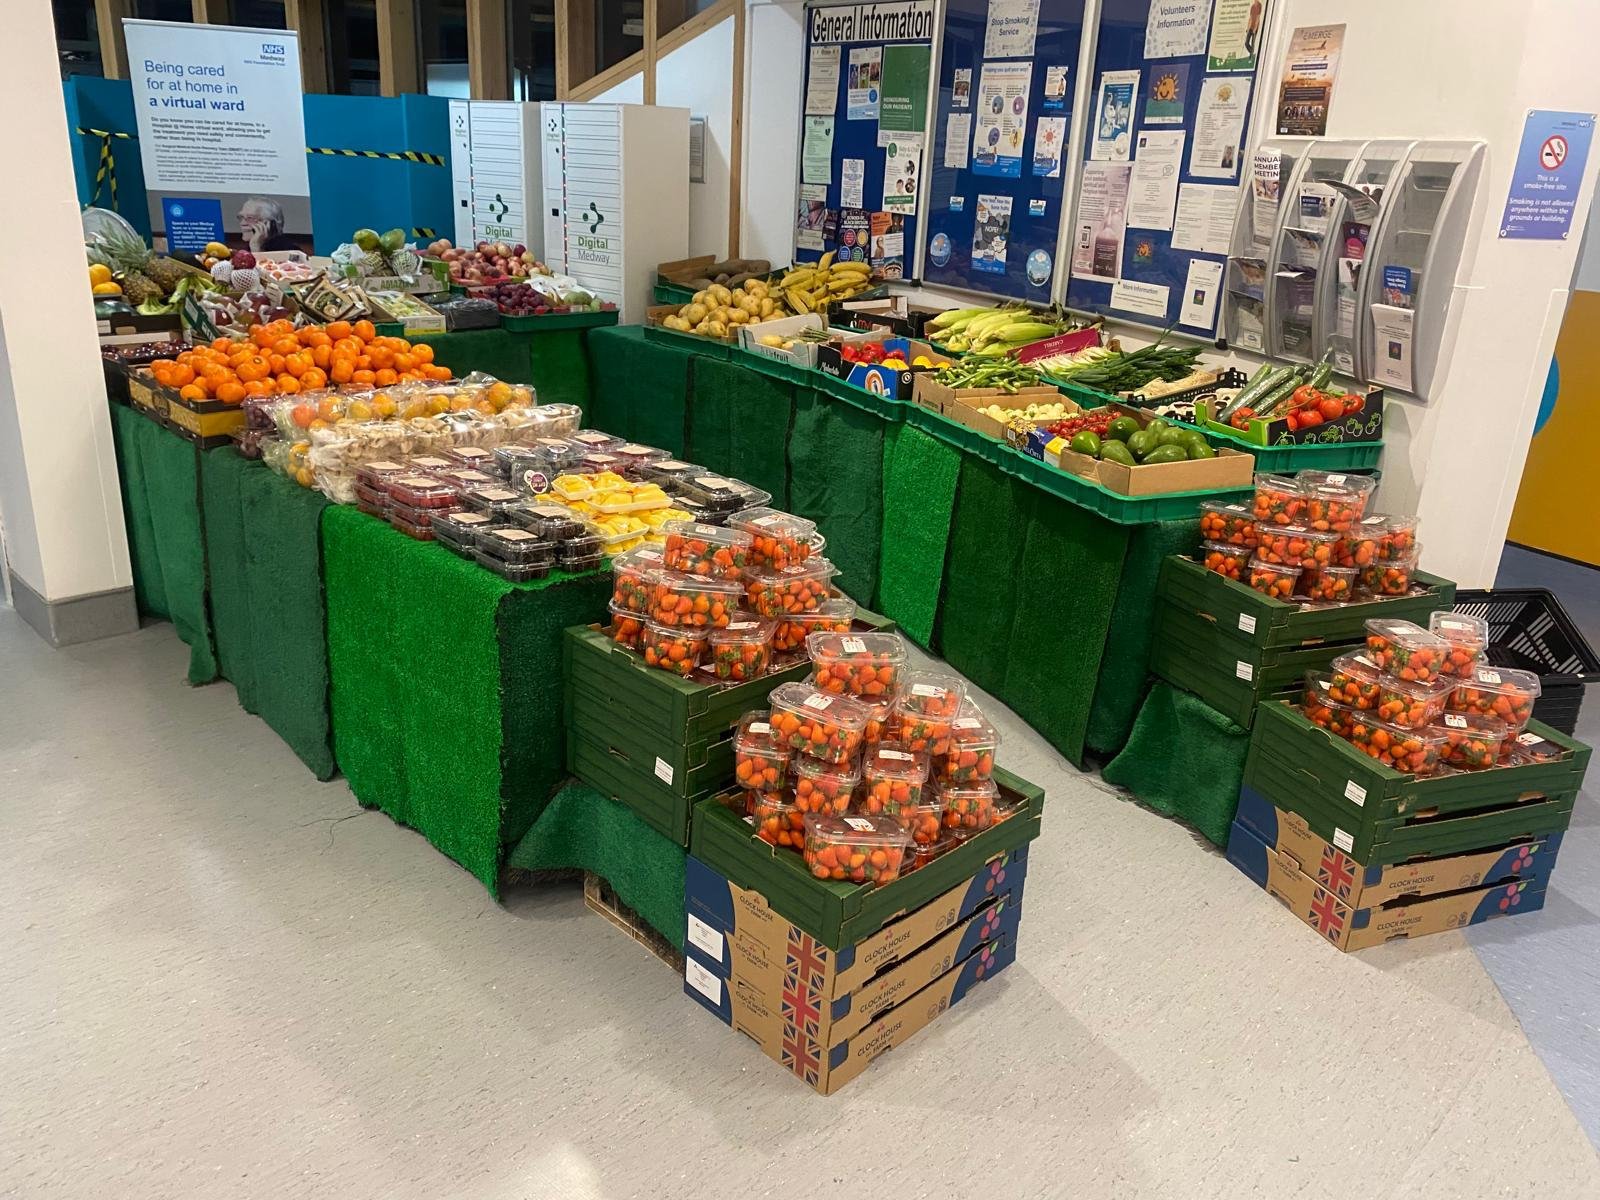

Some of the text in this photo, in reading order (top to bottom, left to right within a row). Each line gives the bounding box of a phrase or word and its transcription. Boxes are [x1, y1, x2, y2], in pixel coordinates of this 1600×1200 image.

[1160, 5, 1195, 16] Volunteers
[812, 3, 932, 42] General Information
[1005, 16, 1029, 25] Smoking
[1157, 17, 1195, 28] Information
[263, 44, 284, 54] NHS
[144, 60, 224, 76] Being cared
[147, 78, 238, 94] for at home in
[150, 96, 244, 111] a virtual ward
[1542, 215, 1566, 223] building.
[485, 225, 513, 238] Digital
[578, 236, 608, 249] Digital
[578, 250, 610, 264] Medway
[1134, 285, 1158, 294] Information
[1284, 818, 1312, 840] CLOCK HOUSE
[1389, 875, 1435, 888] CLOCK HOUSE
[740, 896, 773, 921] CLOCK HOUSE
[1377, 916, 1423, 930] CLOCK HOUSE
[864, 930, 911, 963] CLOCK HOUSE
[736, 943, 769, 970] CLOCK HOUSE
[860, 979, 905, 1013] CLOCK HOUSE
[736, 991, 768, 1017] CLOCK HOUSE
[858, 1021, 902, 1056] CLOCK HOUSE
[873, 1040, 887, 1053] FARM
